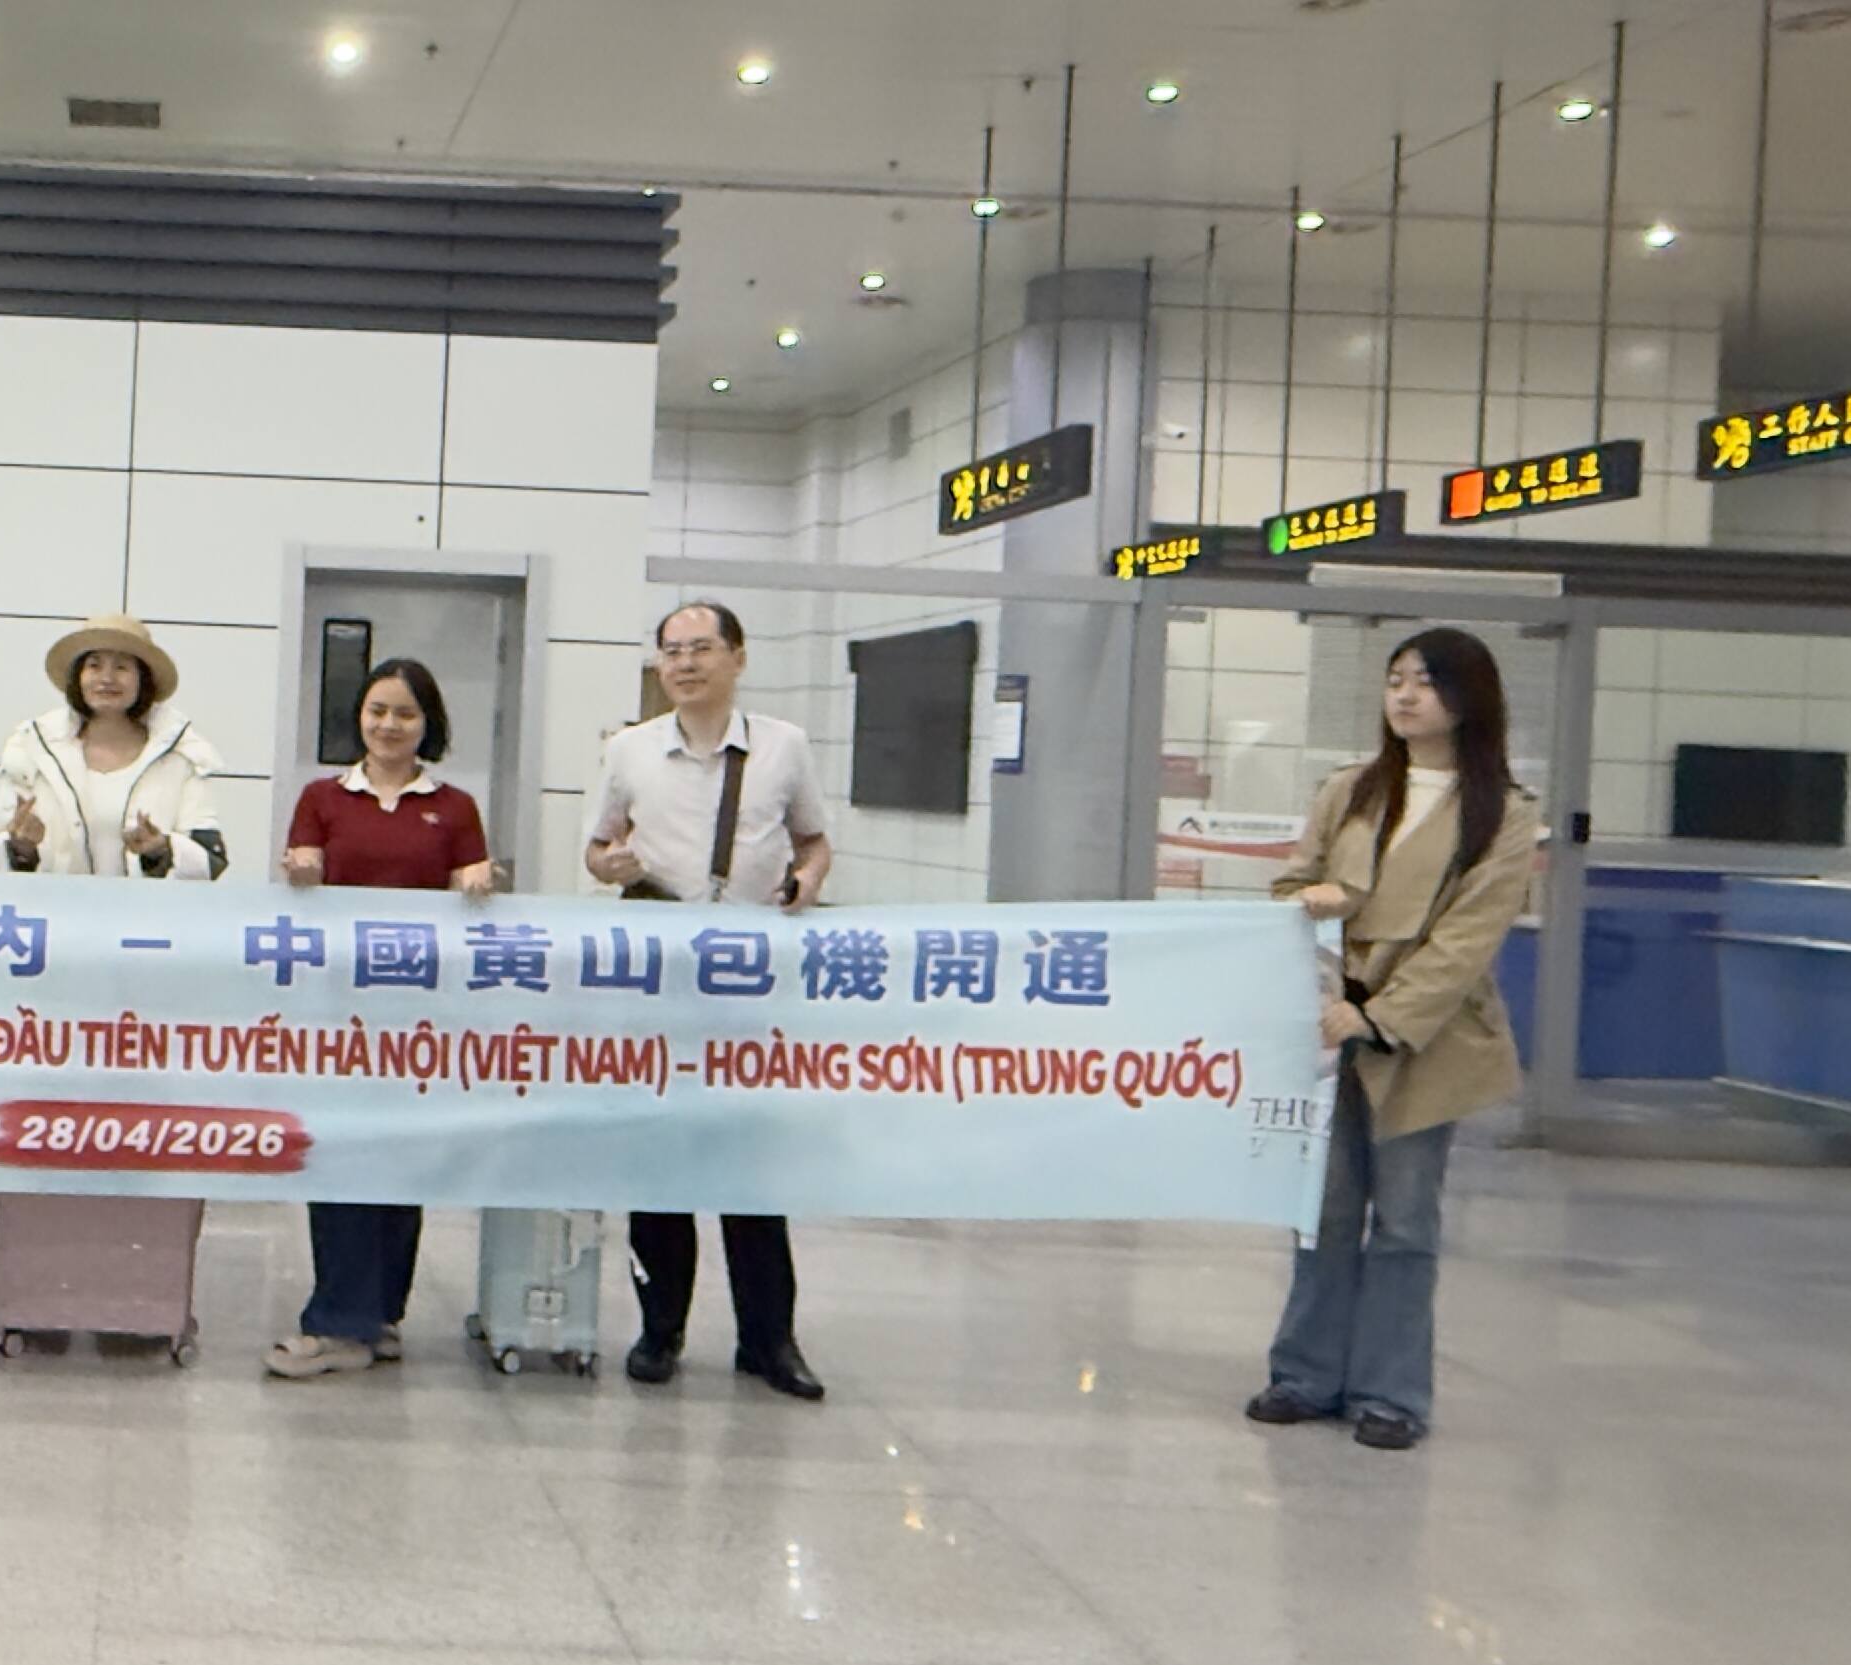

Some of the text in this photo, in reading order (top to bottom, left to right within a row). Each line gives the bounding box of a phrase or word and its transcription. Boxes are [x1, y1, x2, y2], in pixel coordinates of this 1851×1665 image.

[78, 1010, 169, 1070] TIÊN
[176, 1012, 308, 1075] TUYẾN
[315, 1014, 373, 1077] HÀ
[378, 1020, 451, 1095] NỘI
[458, 1023, 560, 1097] (VIỆT
[564, 1034, 668, 1097] NAM)
[705, 1027, 852, 1091] HOÀNG
[857, 1035, 944, 1094] SƠN
[952, 1042, 1108, 1104] (TRUNG
[1113, 1037, 1242, 1109] QUỐC)
[16, 1115, 286, 1157] 28/04/2026
